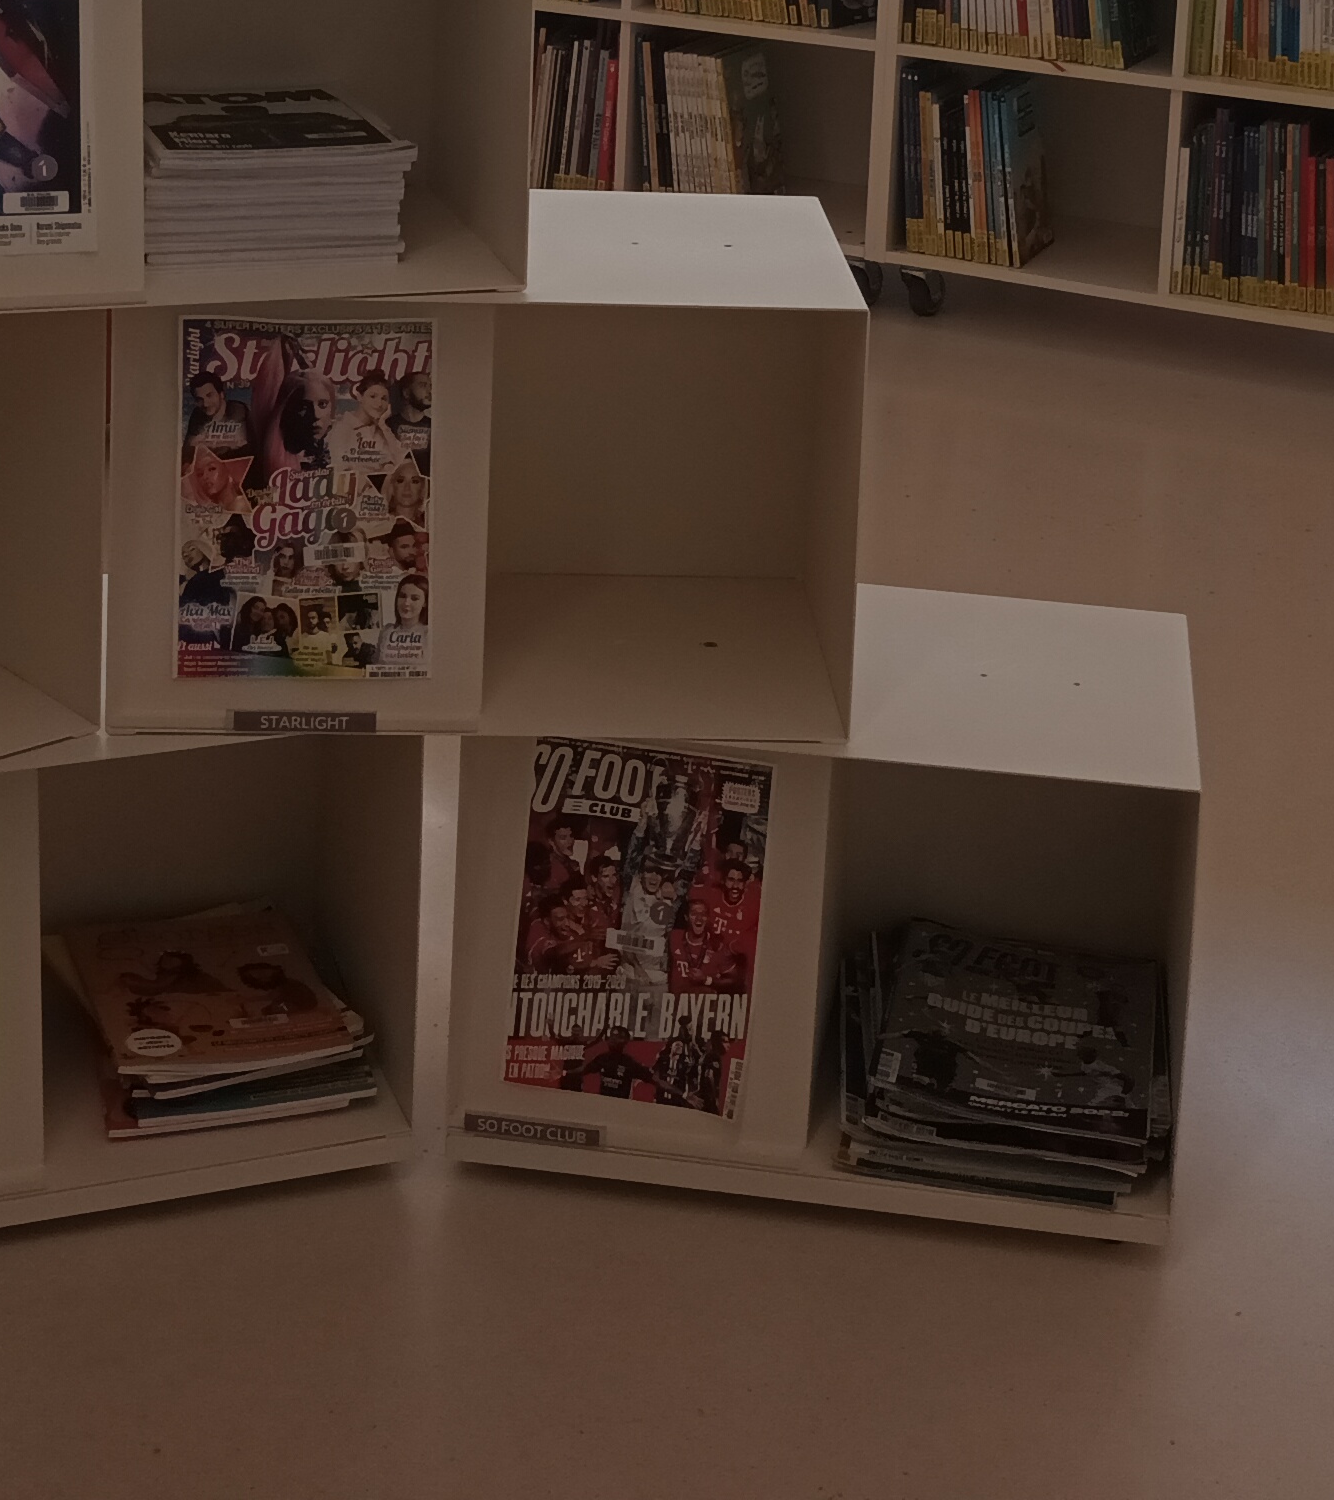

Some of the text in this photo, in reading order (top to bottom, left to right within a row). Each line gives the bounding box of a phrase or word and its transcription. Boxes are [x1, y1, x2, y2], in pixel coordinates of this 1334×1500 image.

[214, 321, 251, 331] SUPER
[253, 323, 301, 333] POSTERS
[303, 324, 362, 335] EXCLUSIFS
[271, 468, 357, 510] Lady
[260, 715, 349, 731] STARLIGHT
[572, 749, 657, 804] FOO
[588, 802, 633, 819] CLUB
[659, 992, 748, 1040] BAYERN
[965, 1018, 1080, 1050] D'EUROPE
[477, 1118, 587, 1144] SO FOOT CLUB
